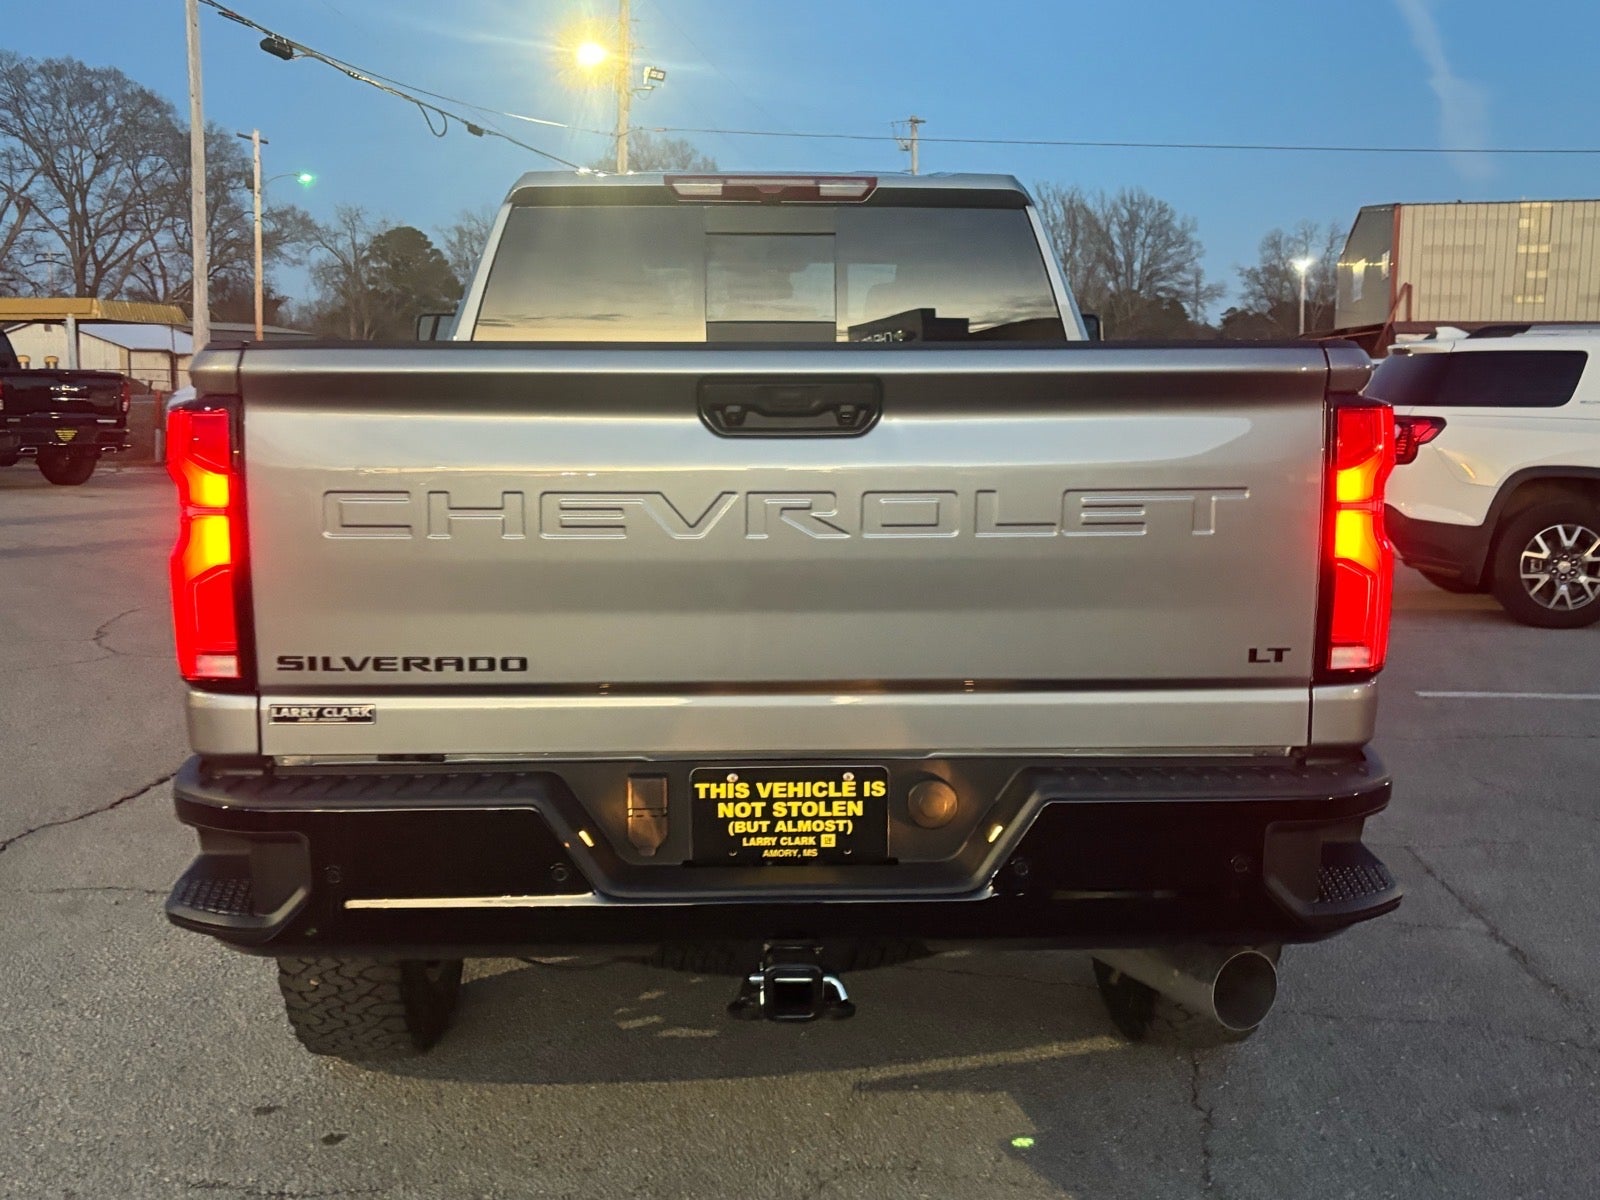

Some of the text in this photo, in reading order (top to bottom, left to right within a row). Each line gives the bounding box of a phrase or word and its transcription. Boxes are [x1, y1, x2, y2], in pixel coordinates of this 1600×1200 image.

[322, 488, 1250, 540] CHEVROLET
[1248, 647, 1291, 663] LT
[276, 655, 528, 672] SILVERADO
[271, 707, 373, 718] LARRY CLARK
[694, 781, 886, 799] THIS VEHICLE IS
[717, 800, 864, 818] NOT STOLEN
[727, 820, 853, 836] (BUT ALMOST)
[742, 837, 777, 847] LARRY
[780, 836, 817, 846] CLARK
[762, 848, 818, 858] AMORY, MS
